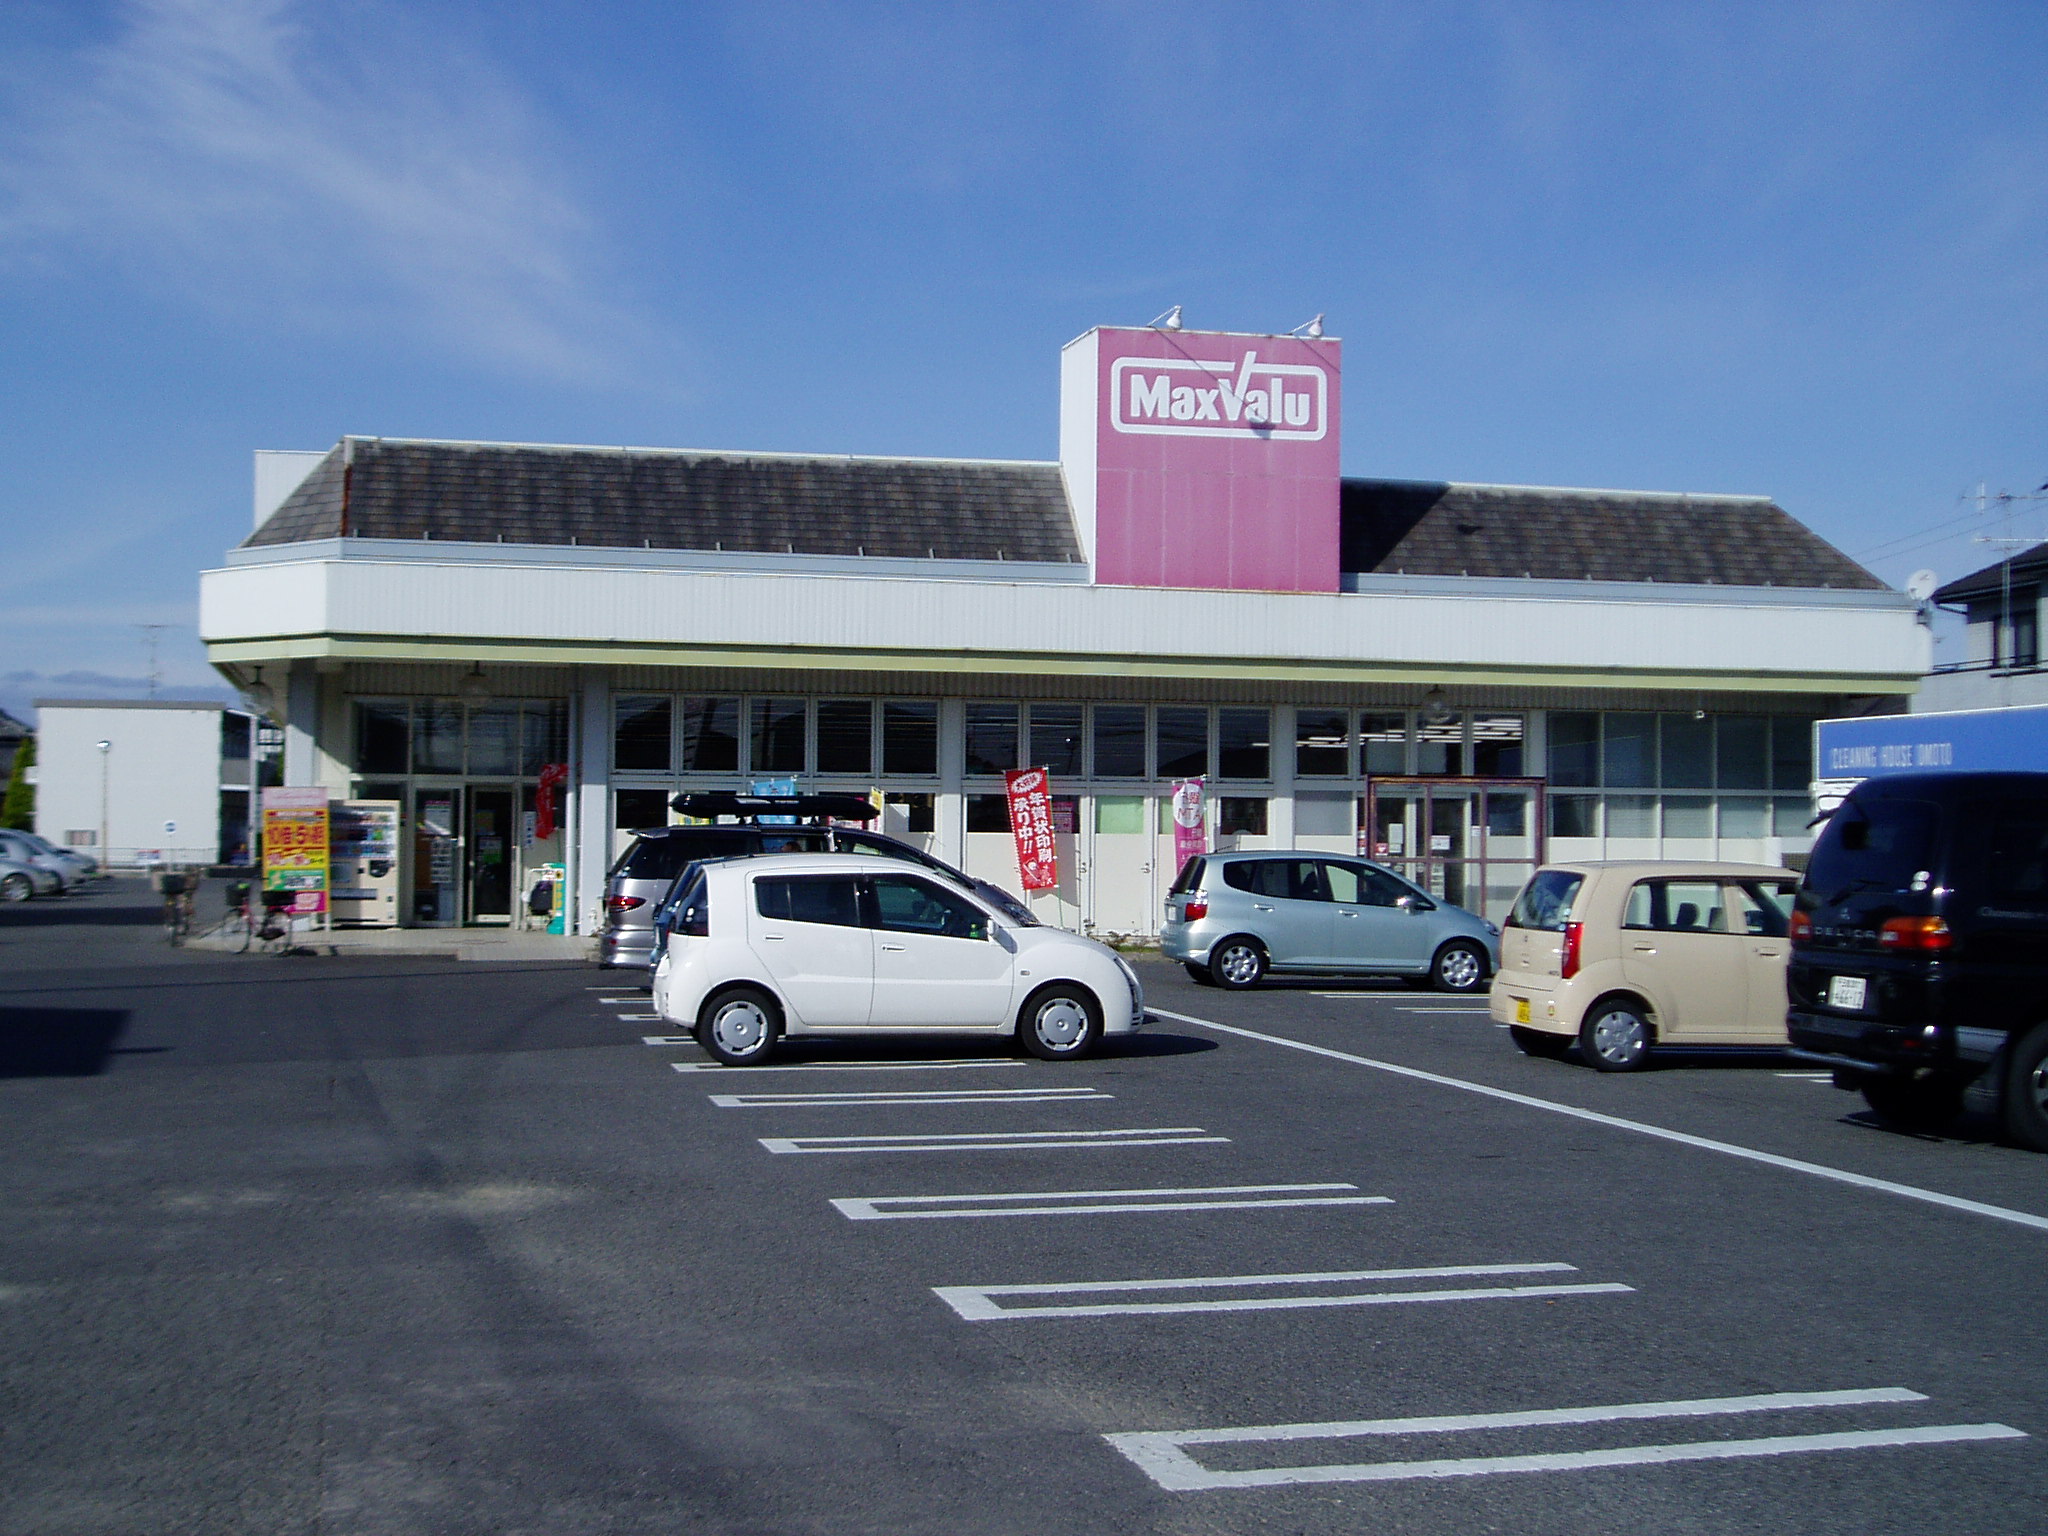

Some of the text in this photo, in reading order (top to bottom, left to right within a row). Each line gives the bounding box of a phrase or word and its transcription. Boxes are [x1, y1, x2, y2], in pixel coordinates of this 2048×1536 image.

[1130, 351, 1311, 426] MaxValu
[1832, 746, 1876, 769] CLEANING
[1881, 745, 1913, 767] HOUSE
[1029, 792, 1053, 863] 年賀状印刷
